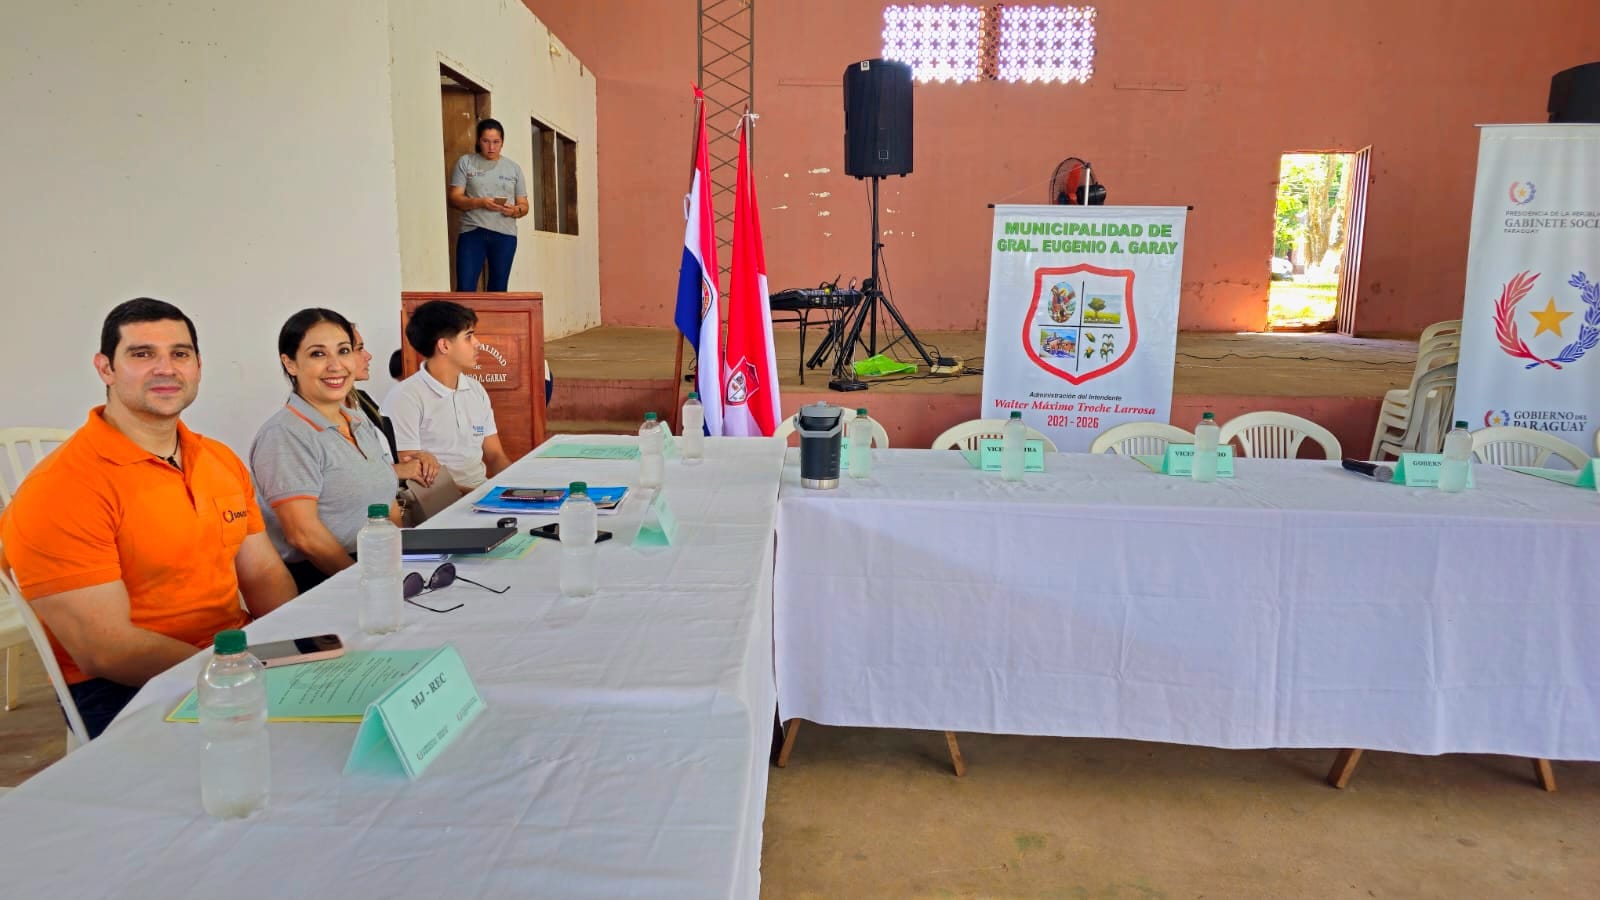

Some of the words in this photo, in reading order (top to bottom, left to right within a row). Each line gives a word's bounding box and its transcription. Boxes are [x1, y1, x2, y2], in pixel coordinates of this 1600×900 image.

[1004, 222, 1144, 237] MUNICIPALIDAD
[1148, 223, 1173, 238] DE
[1504, 218, 1568, 228] GABINETE
[1570, 218, 1600, 229] SOCI
[1042, 239, 1107, 254] EUGENIO
[1109, 240, 1125, 254] A.
[1128, 241, 1178, 255] GARAY
[485, 373, 507, 383] GARAY
[994, 399, 1029, 409] Walter
[1032, 400, 1074, 411] Máximo
[1077, 402, 1112, 413] Troche
[1114, 404, 1157, 415] Larrosa
[1047, 415, 1068, 427] 2021
[1076, 416, 1100, 429] 2026
[1513, 410, 1575, 420] GOBIERNO
[1513, 420, 1588, 432] PARAGUAY
[411, 691, 426, 710] MJ
[428, 671, 448, 694] REC
